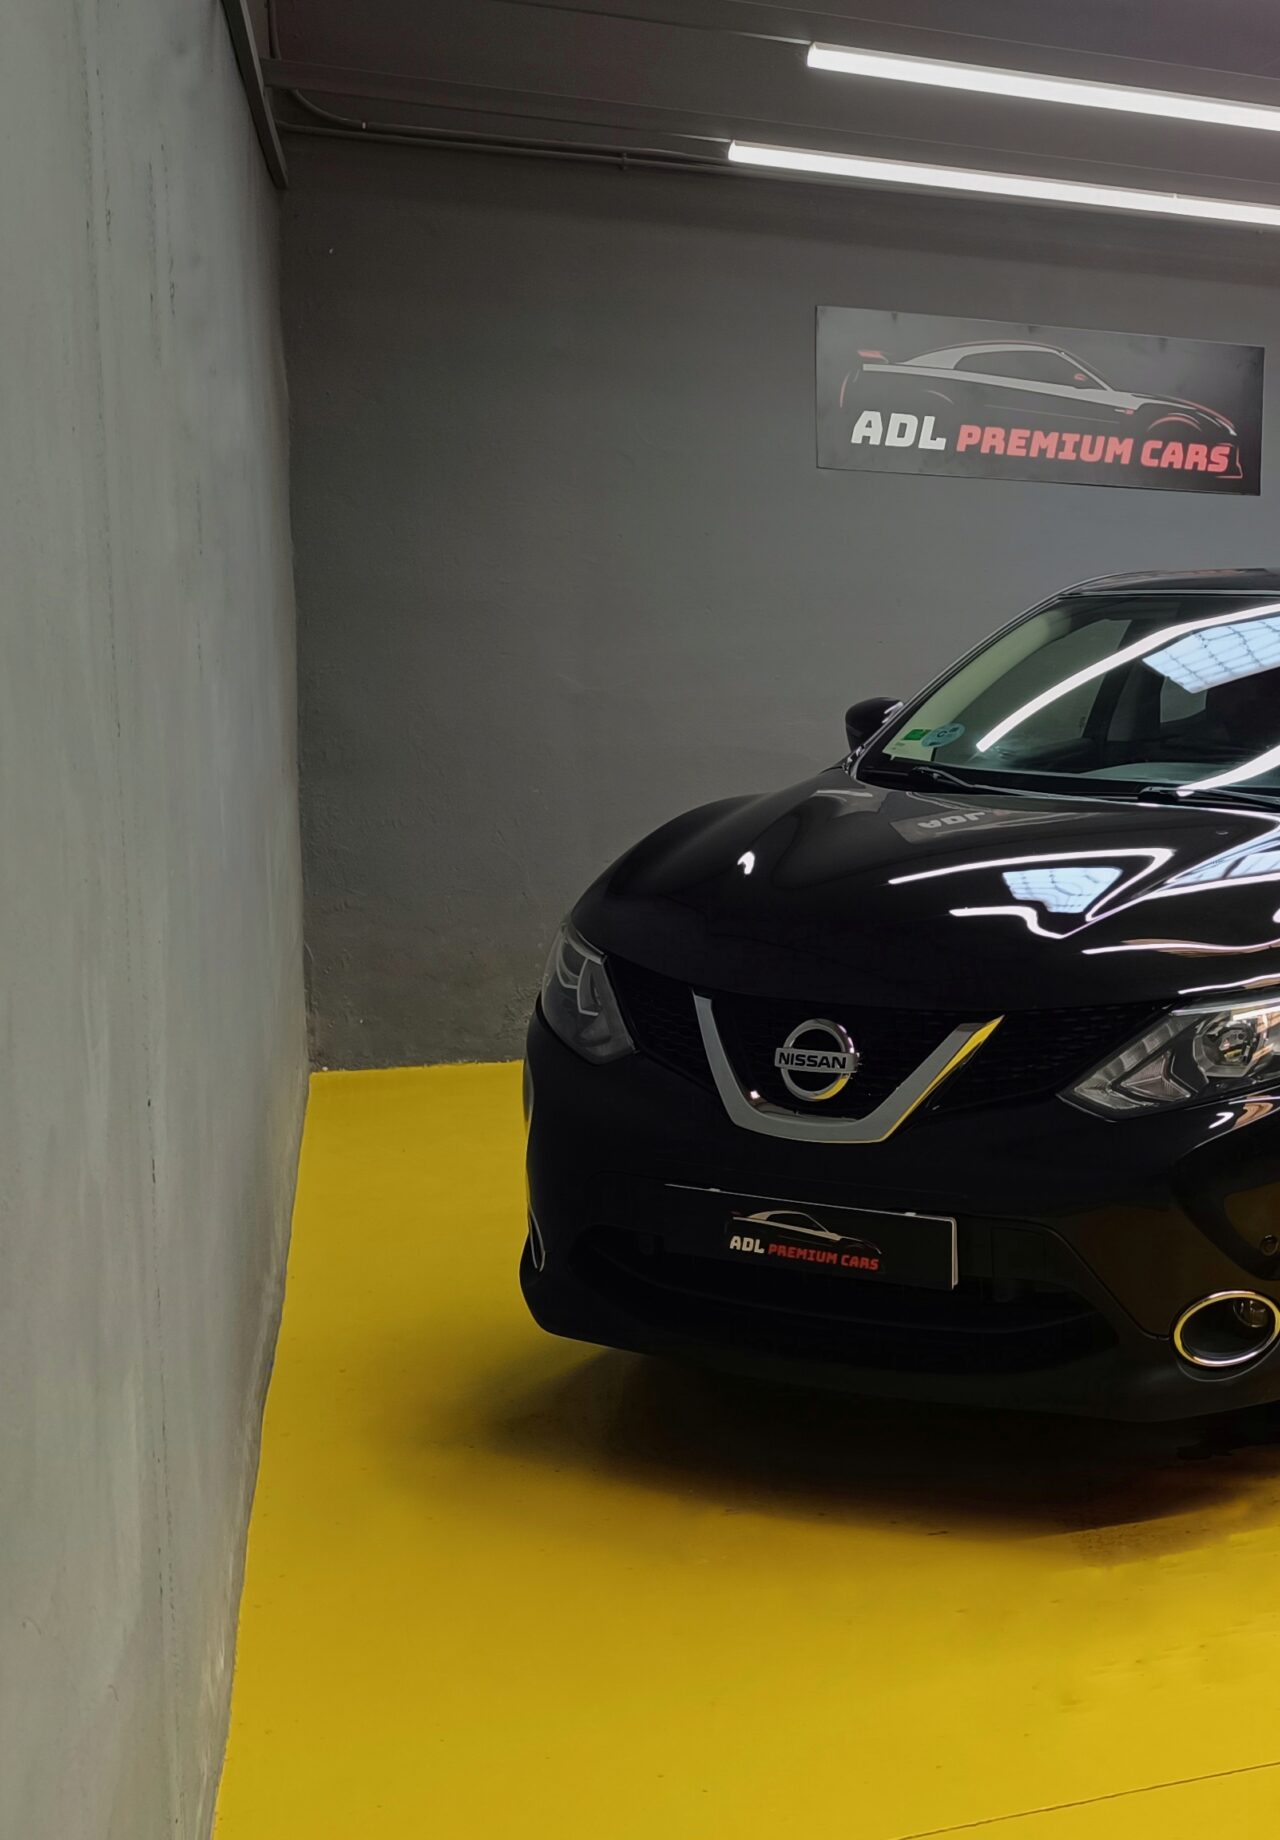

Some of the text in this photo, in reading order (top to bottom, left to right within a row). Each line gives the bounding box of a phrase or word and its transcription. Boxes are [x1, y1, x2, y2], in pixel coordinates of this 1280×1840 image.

[850, 410, 1230, 473] ADL PREMIUM CARS
[778, 1052, 847, 1069] NISSAN
[729, 1235, 880, 1271] ADL PREMIUM CARS
